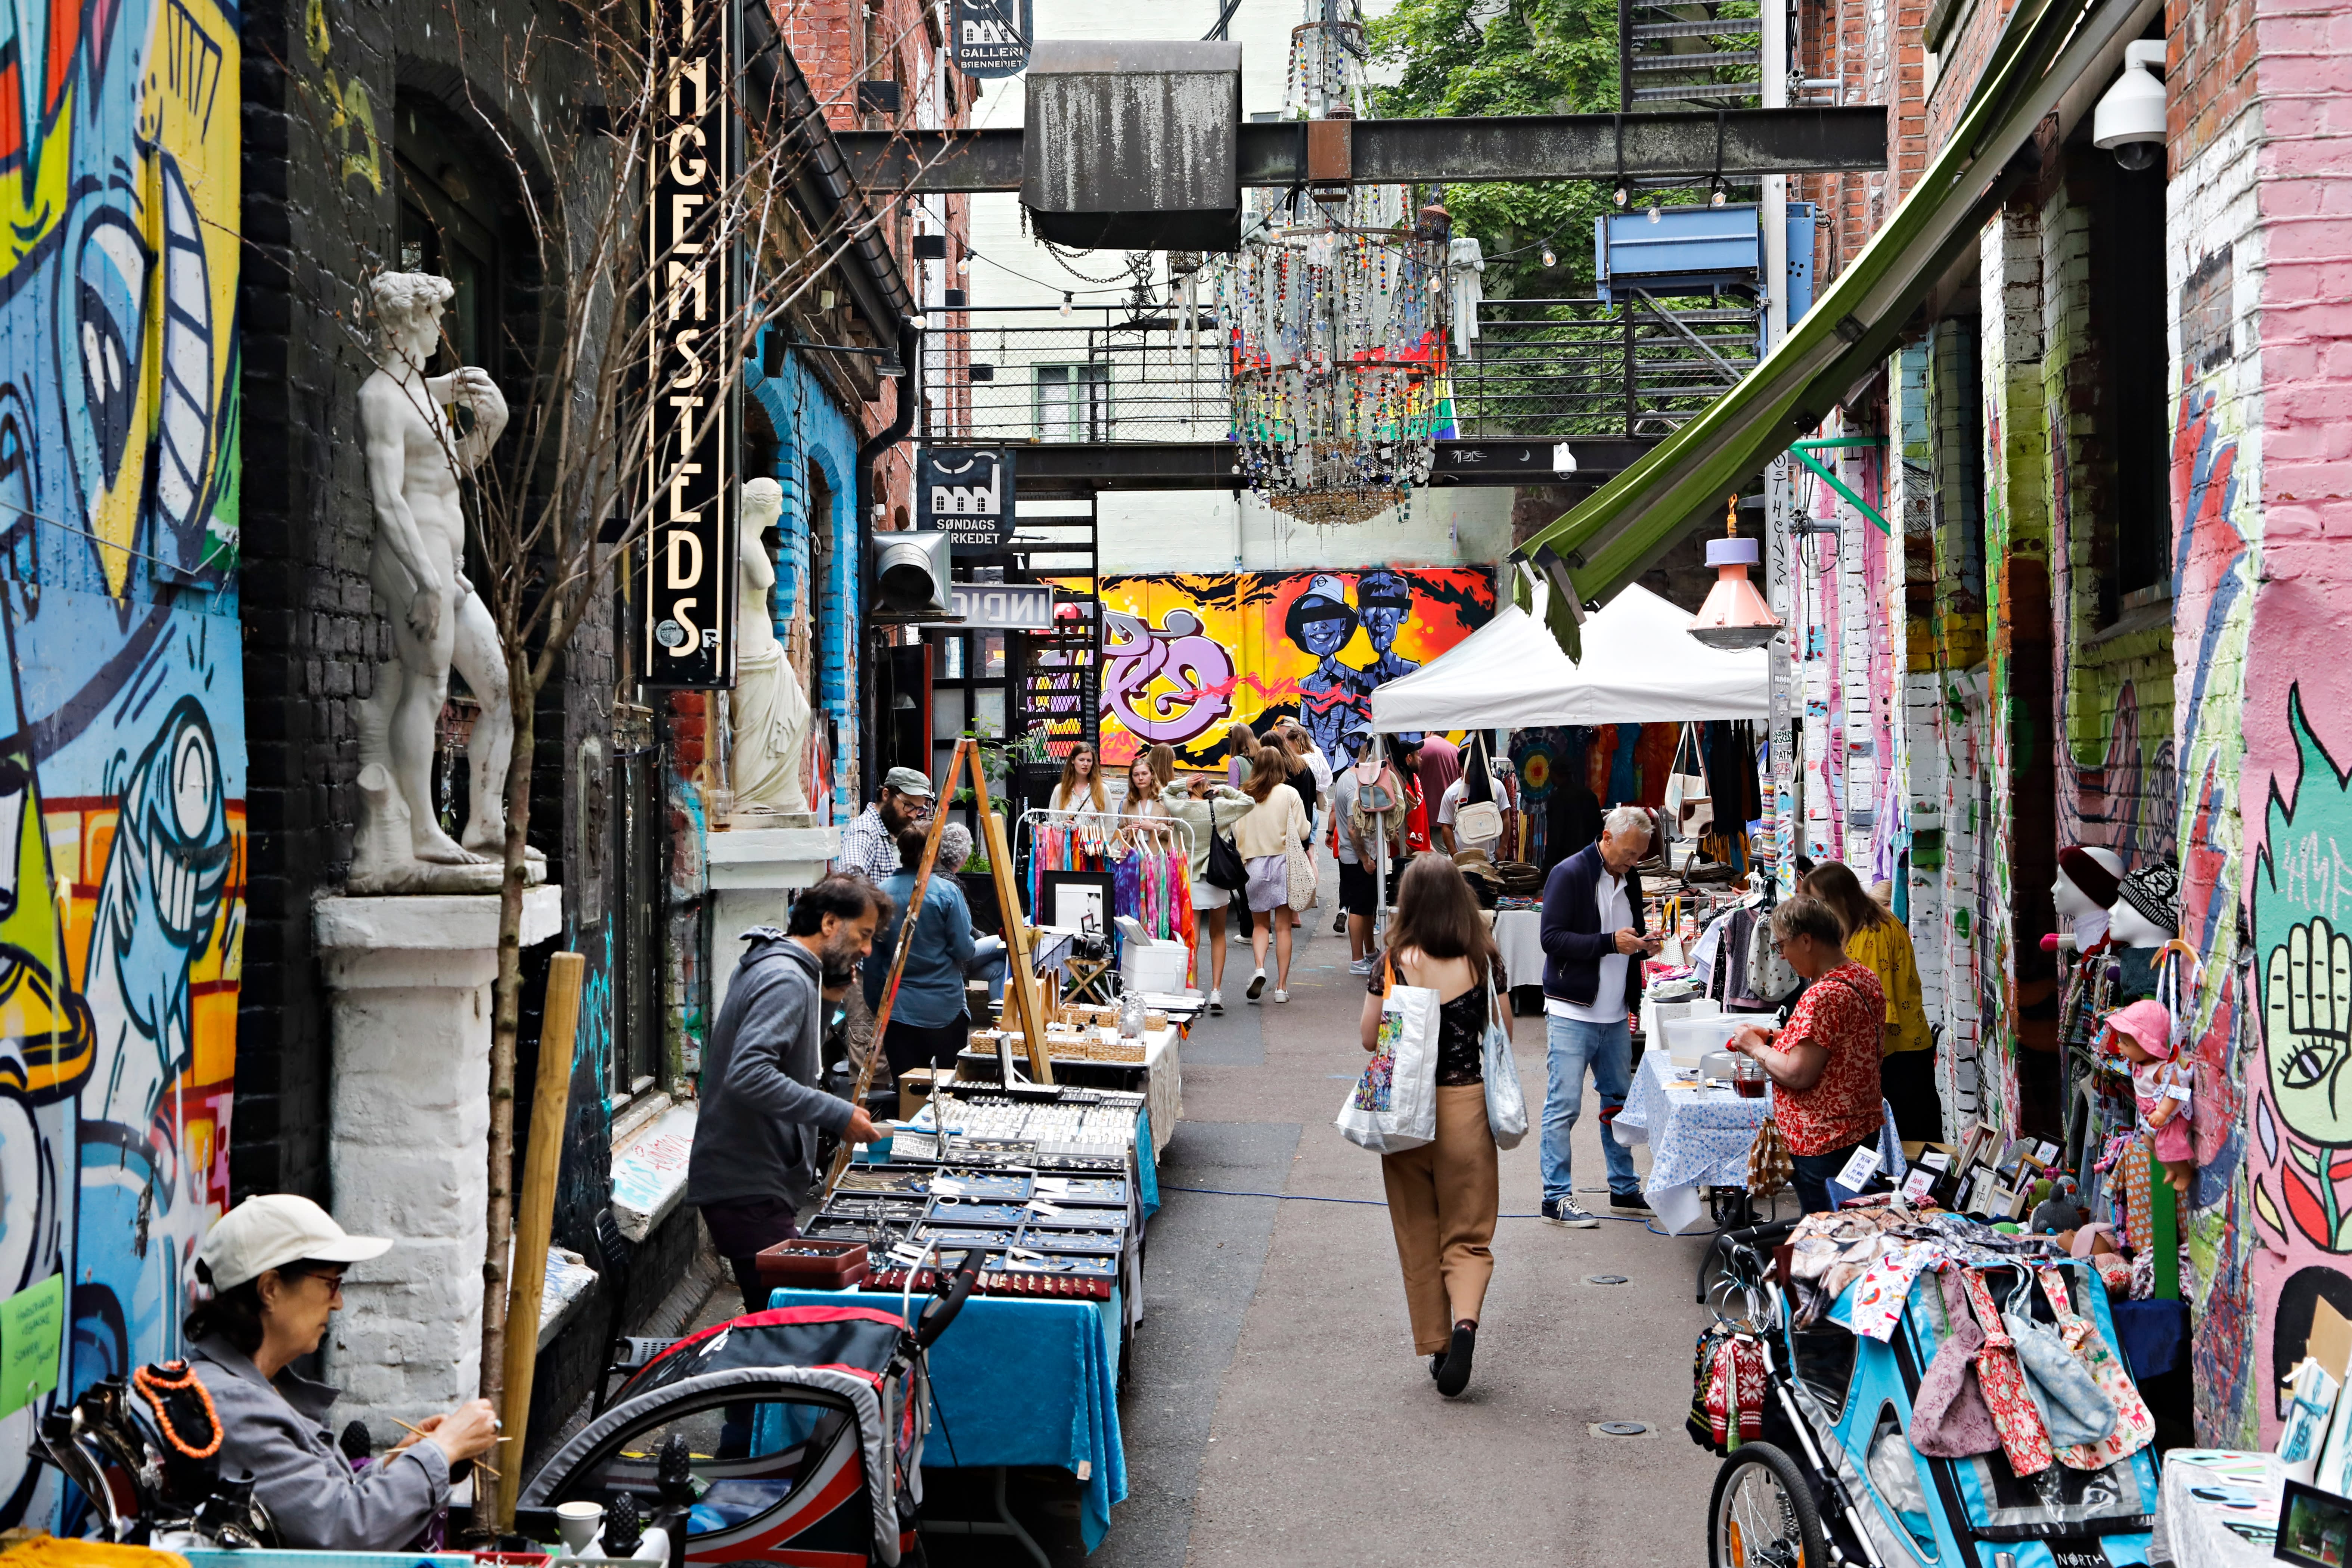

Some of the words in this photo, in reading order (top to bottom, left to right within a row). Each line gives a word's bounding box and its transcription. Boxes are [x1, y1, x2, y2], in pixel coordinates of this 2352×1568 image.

[961, 47, 1023, 58] GALLERI
[937, 519, 995, 530] SØNDAGS
[950, 533, 1000, 544] RKEDET
[2057, 1552, 2105, 1567] NORTH
